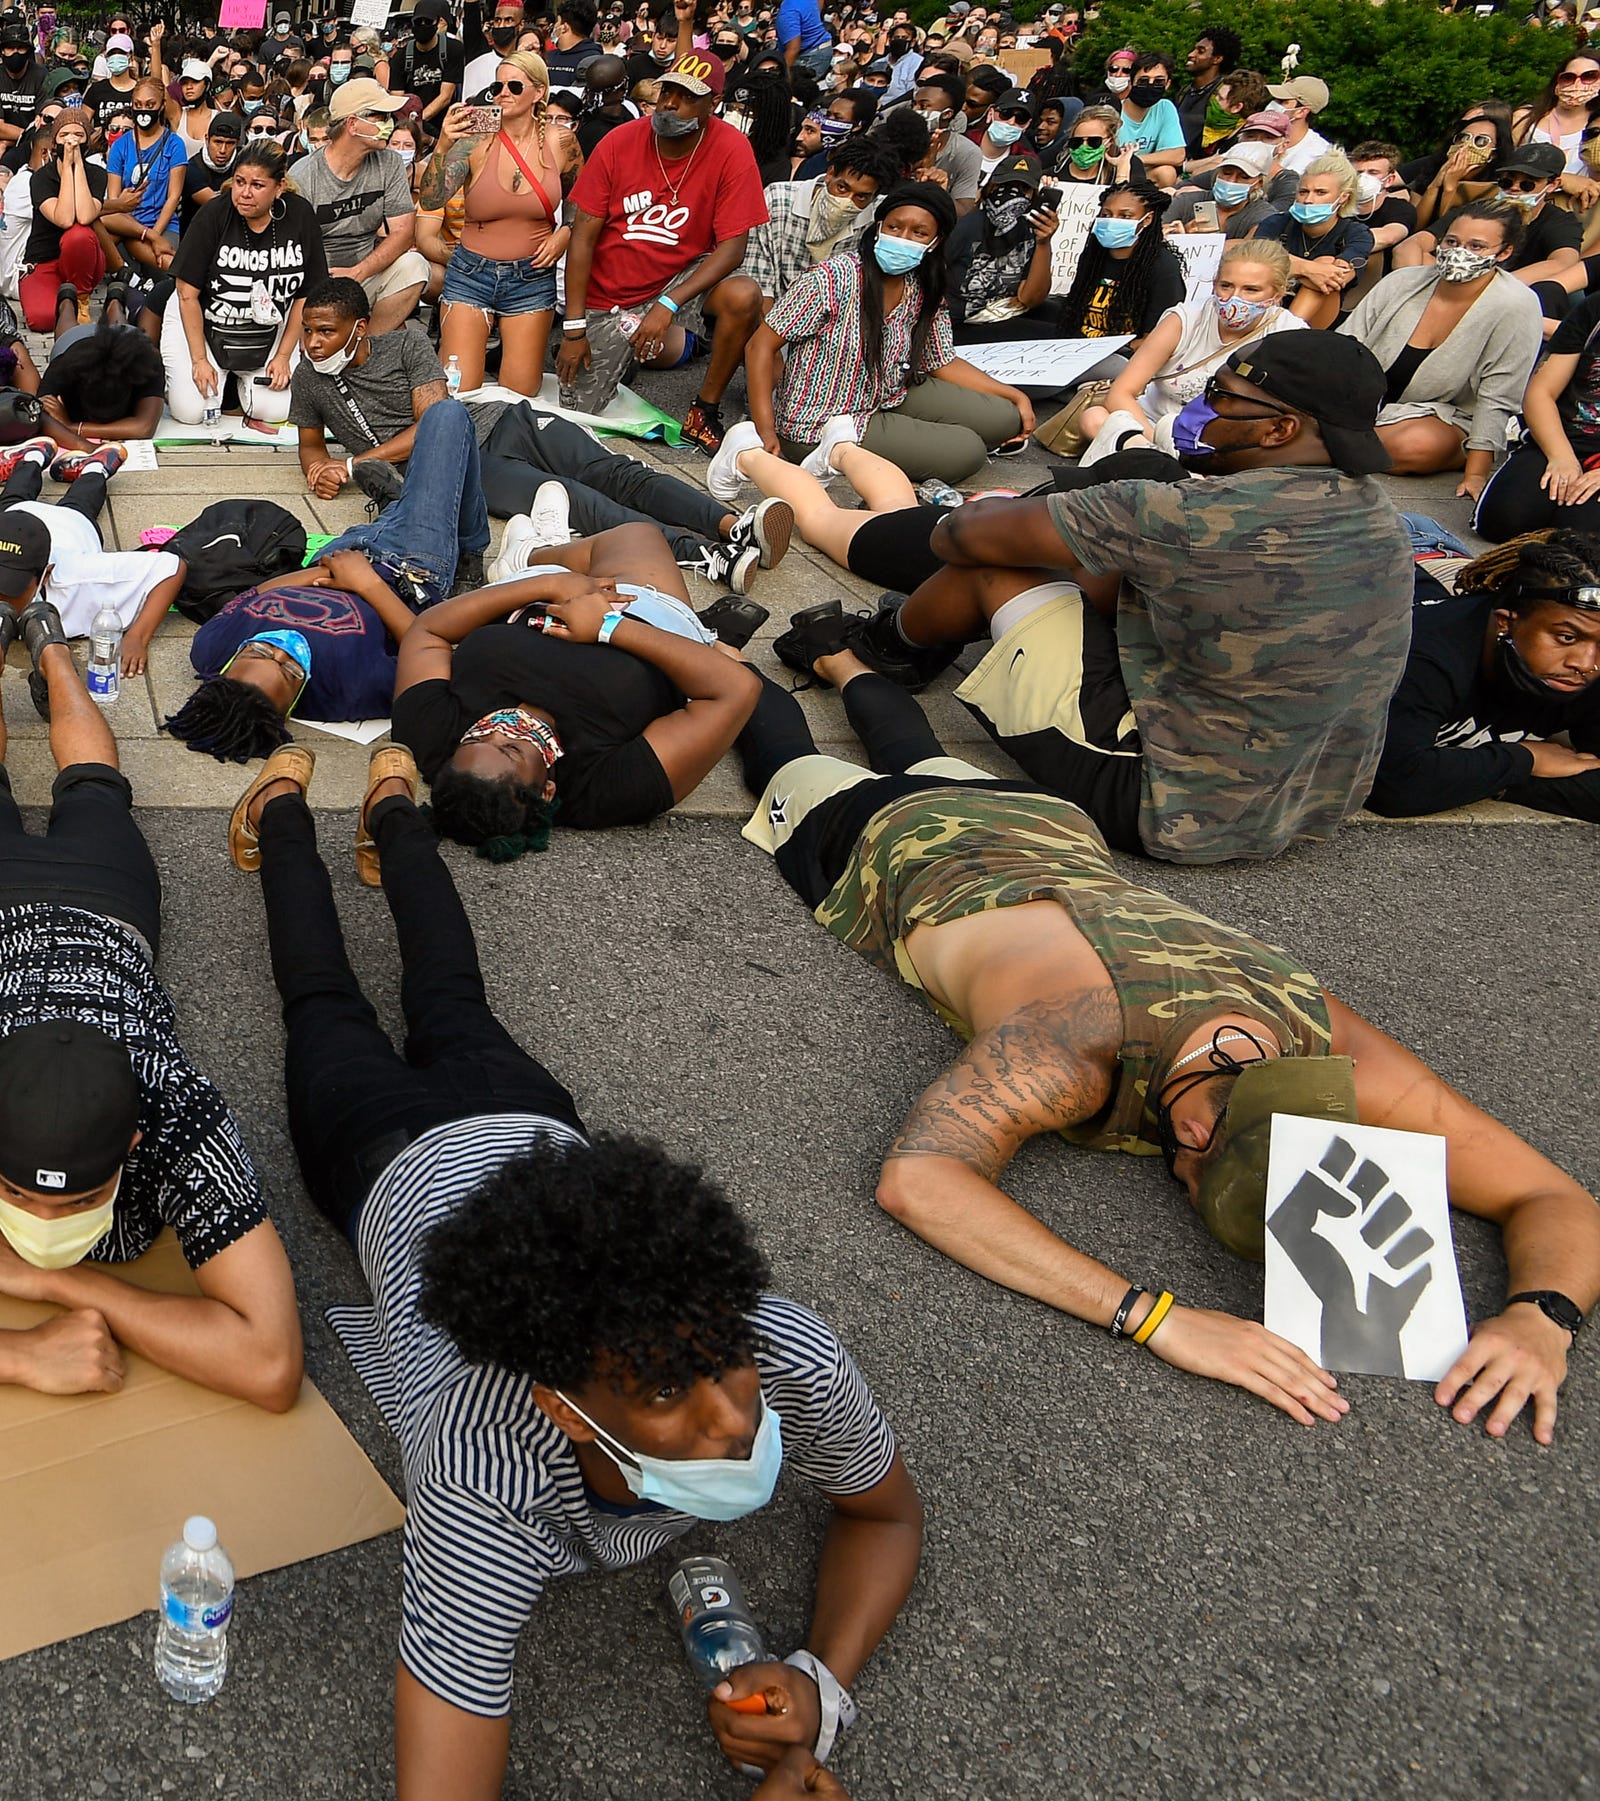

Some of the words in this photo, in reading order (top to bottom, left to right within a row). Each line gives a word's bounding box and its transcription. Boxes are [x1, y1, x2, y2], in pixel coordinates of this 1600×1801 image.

[622, 190, 653, 214] MR
[217, 245, 269, 271] SOMOS
[270, 239, 303, 269] MÁS
[1058, 238, 1078, 251] OF
[272, 276, 301, 297] NO
